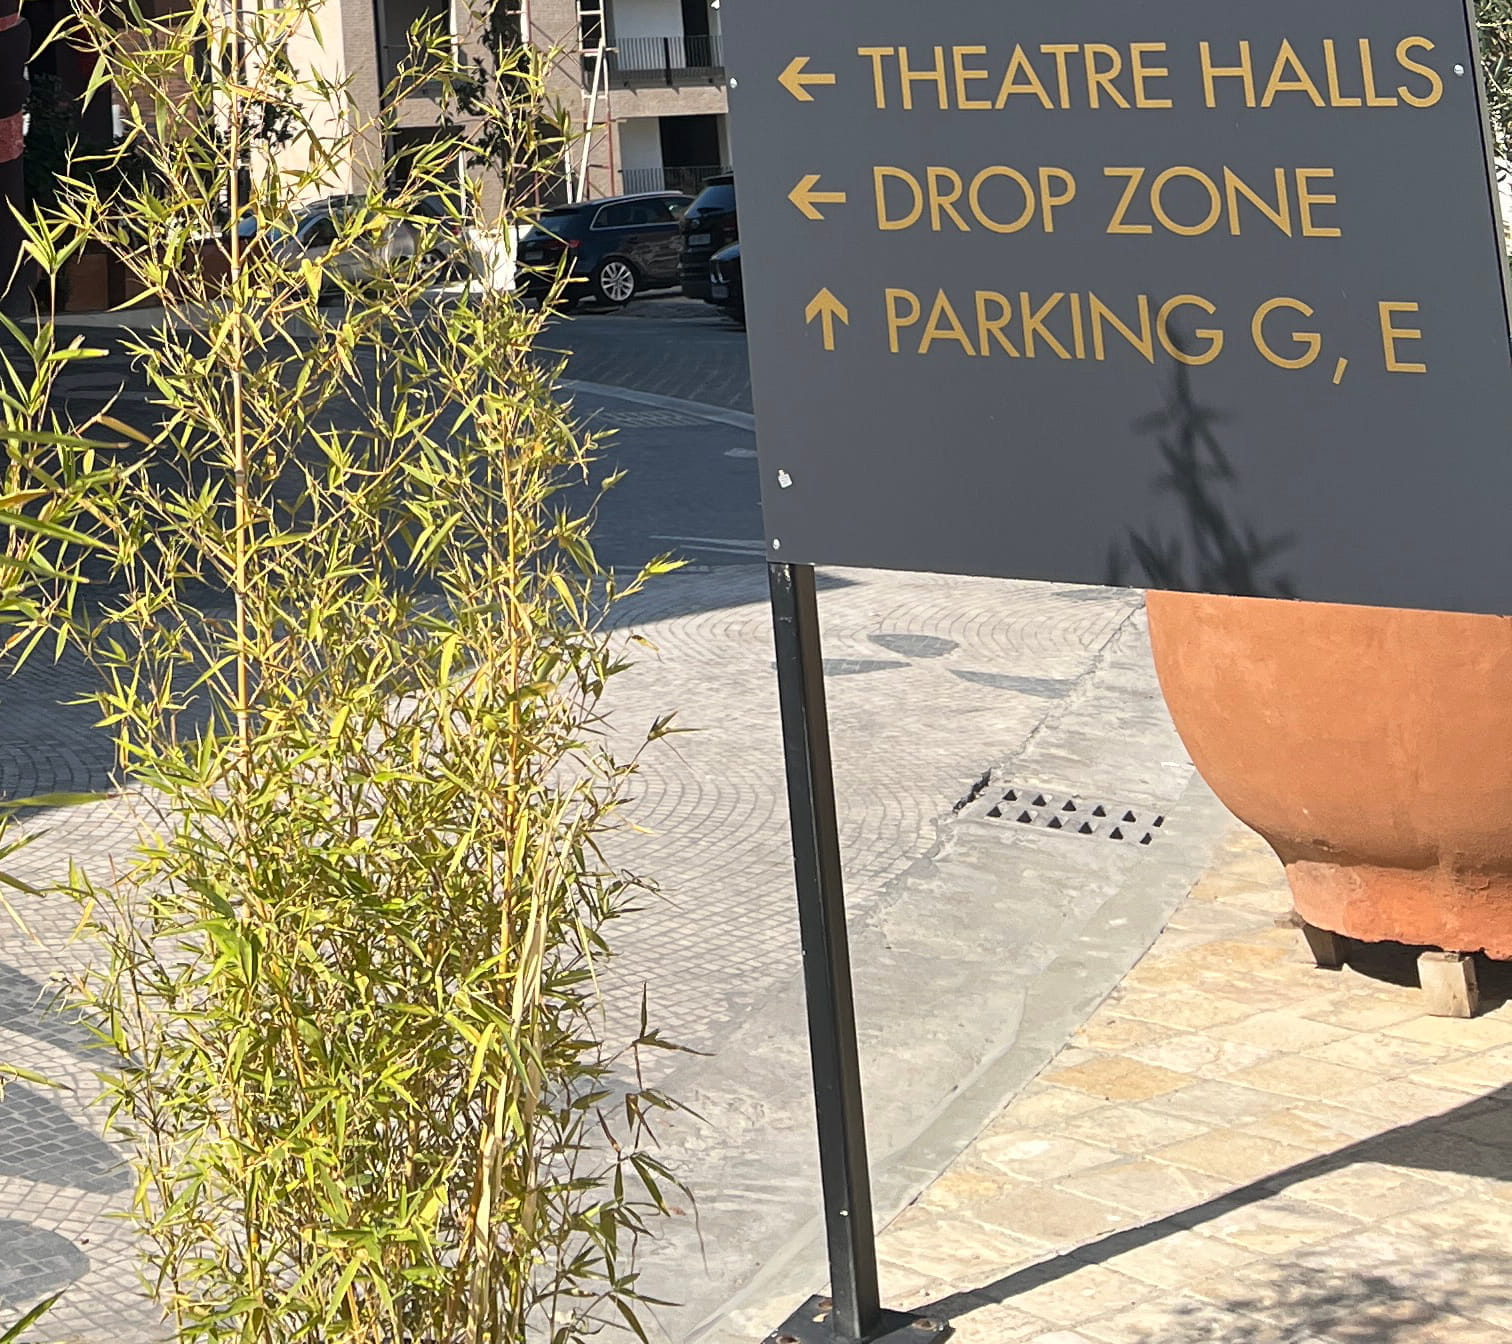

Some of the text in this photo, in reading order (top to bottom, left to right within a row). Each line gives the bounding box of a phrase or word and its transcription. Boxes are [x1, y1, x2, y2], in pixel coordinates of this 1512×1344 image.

[857, 36, 1444, 110] THEATRE HALLS
[872, 165, 1343, 238] DROP ZONE
[884, 287, 1427, 385] PARKING G, E
